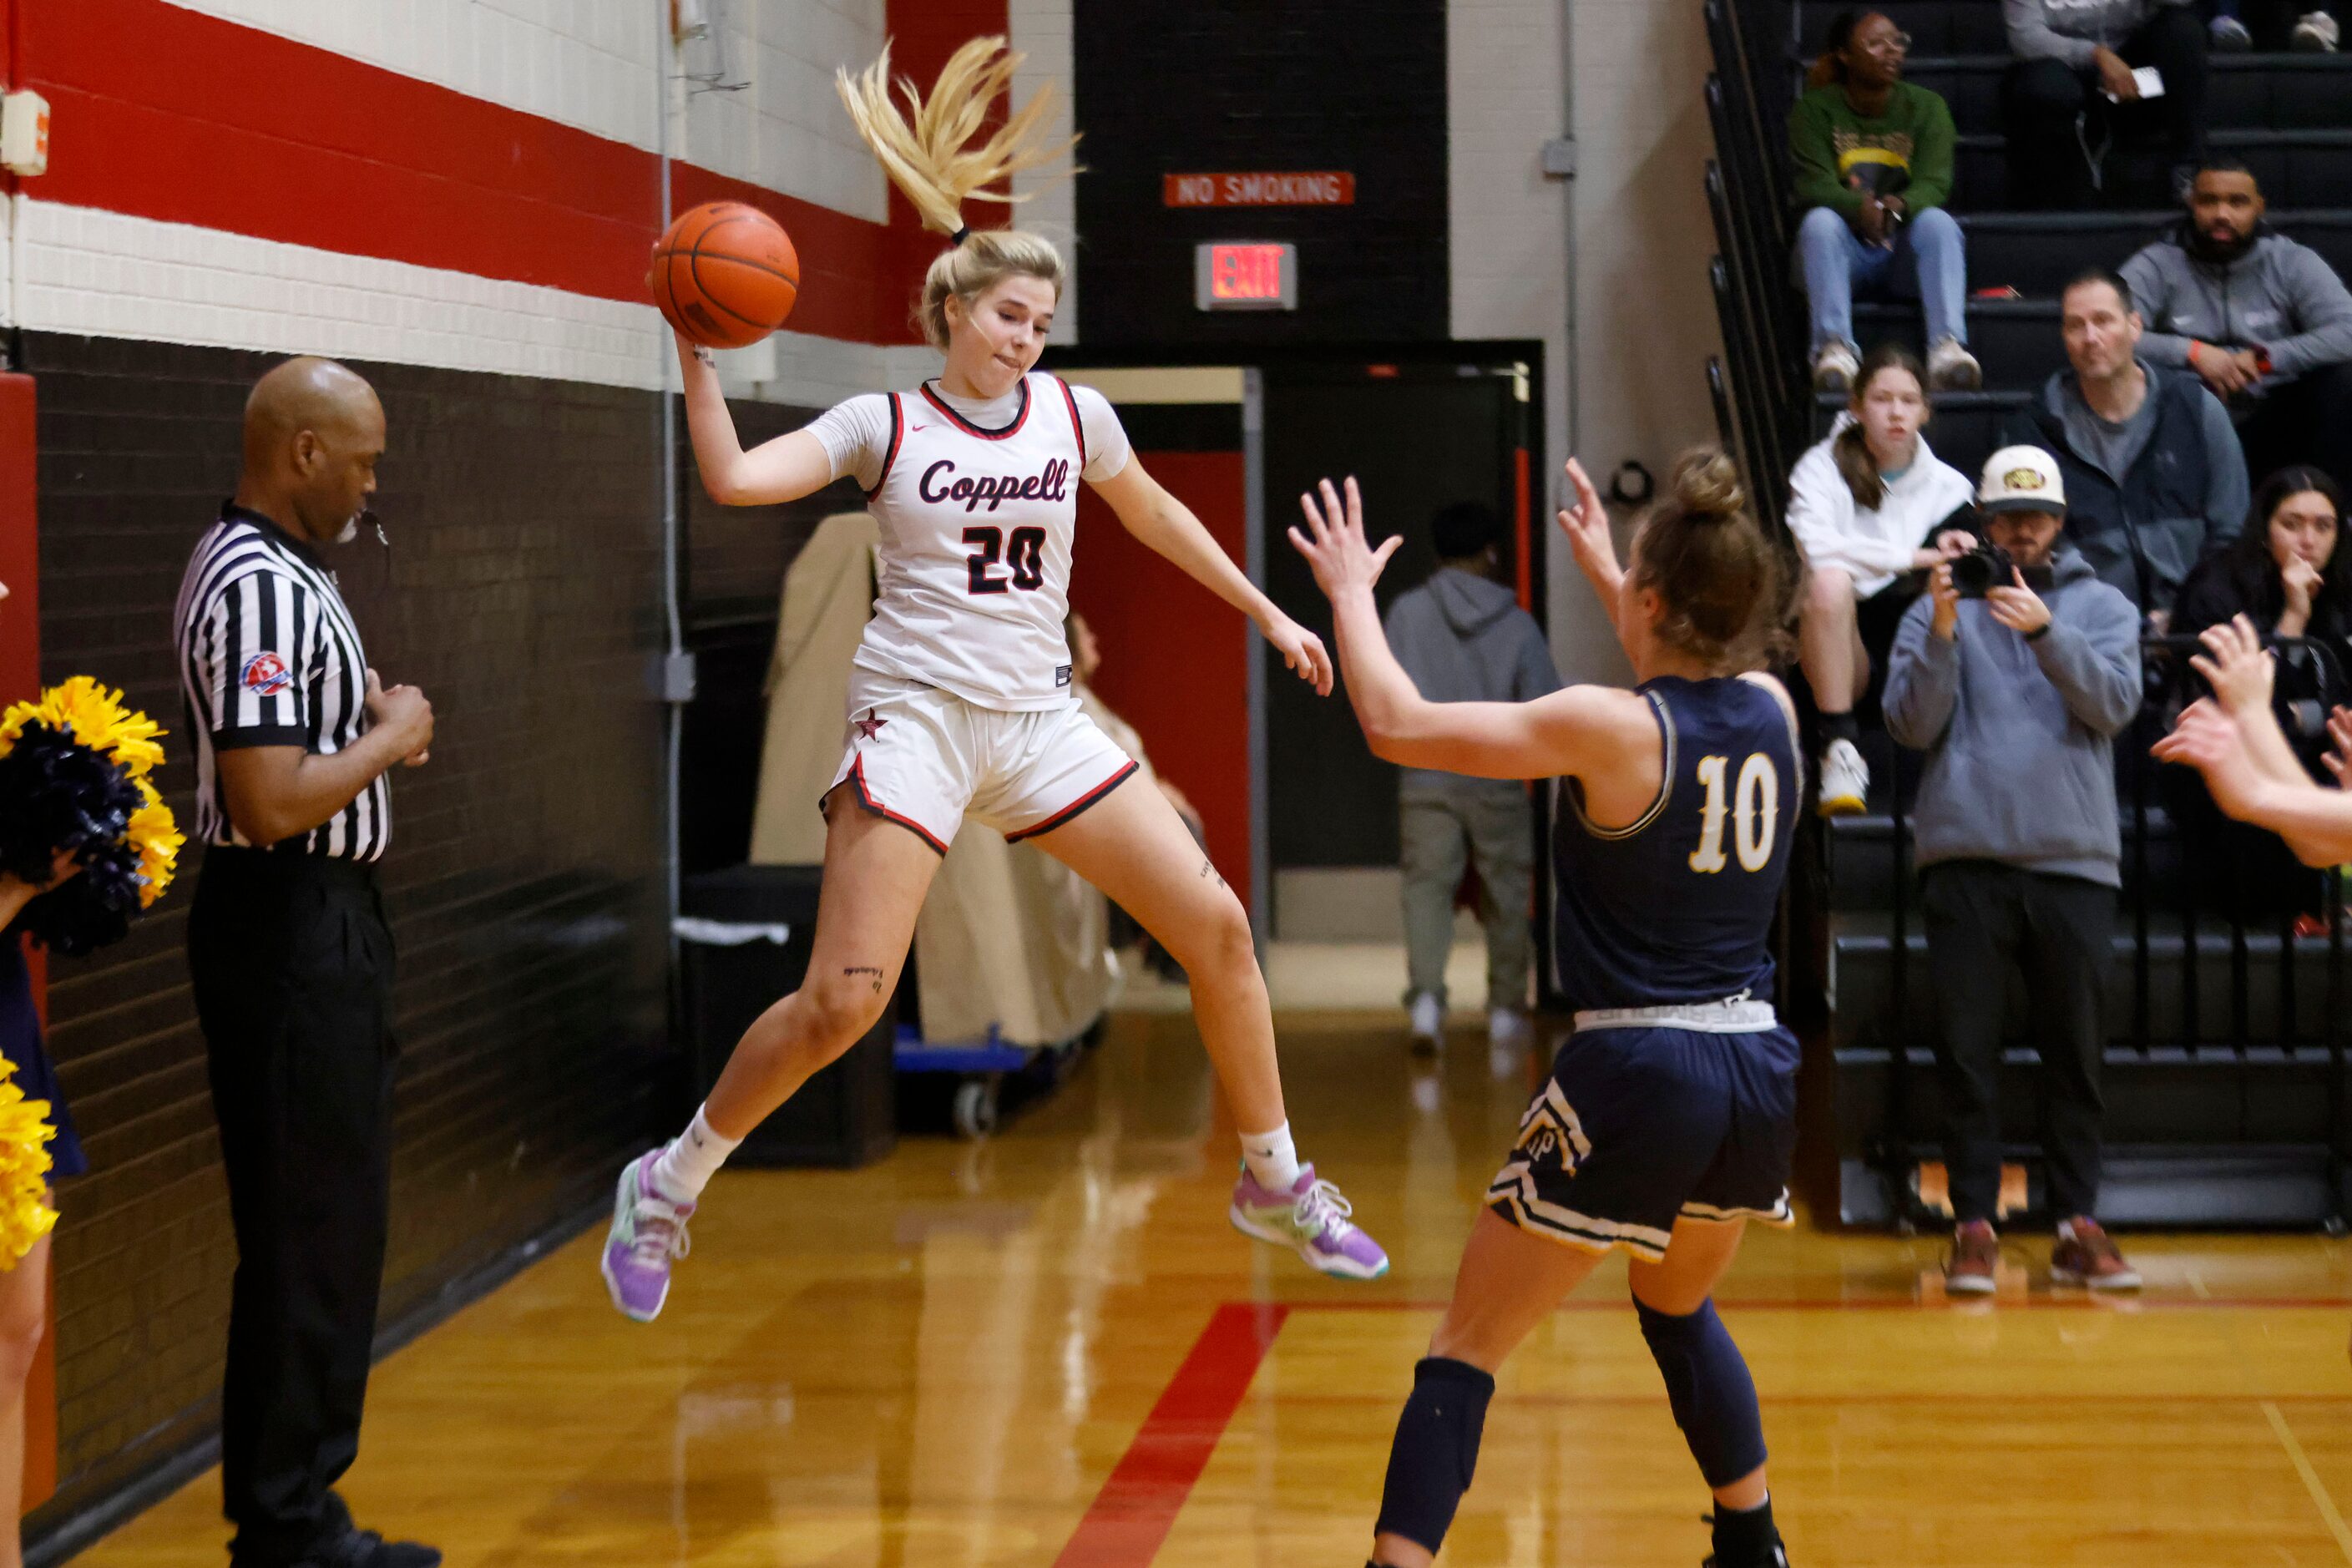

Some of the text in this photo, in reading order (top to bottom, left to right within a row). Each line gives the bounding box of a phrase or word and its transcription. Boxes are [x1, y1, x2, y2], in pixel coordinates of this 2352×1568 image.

[1177, 175, 1341, 203] NO SMOKING
[1212, 245, 1284, 298] EXIT
[919, 458, 1069, 513] Coppell
[962, 526, 1046, 595] 20
[1688, 752, 1779, 874] 10
